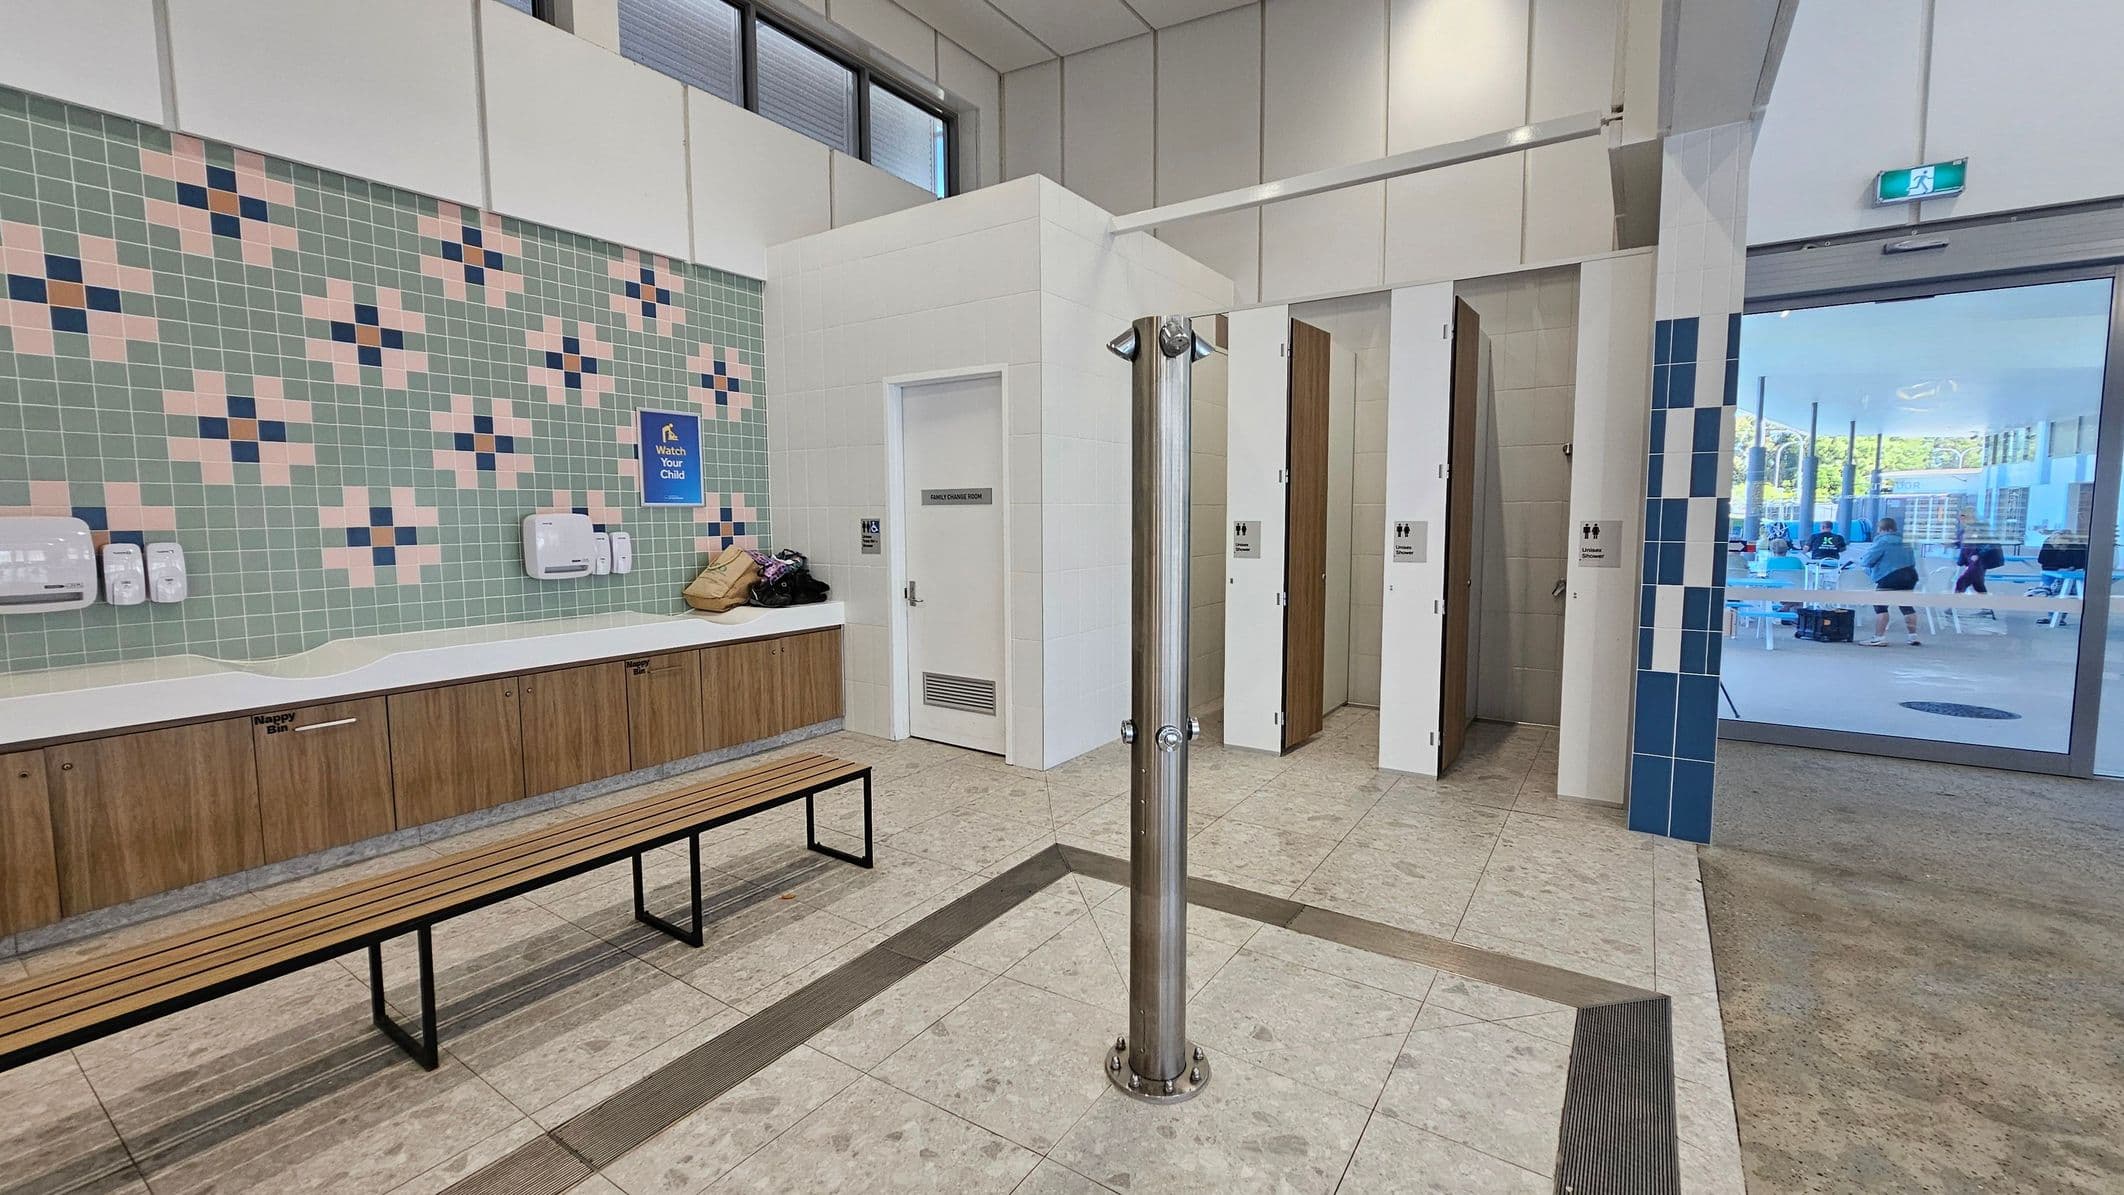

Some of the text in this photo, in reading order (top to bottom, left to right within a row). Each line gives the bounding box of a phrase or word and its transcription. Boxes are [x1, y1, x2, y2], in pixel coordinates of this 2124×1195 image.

[655, 445, 686, 456] Watch
[660, 458, 683, 468] Your
[660, 469, 685, 480] Child
[626, 660, 650, 668] Nappy
[633, 667, 646, 675] Bin
[254, 712, 296, 725] Nappy
[267, 724, 288, 734] Bin
